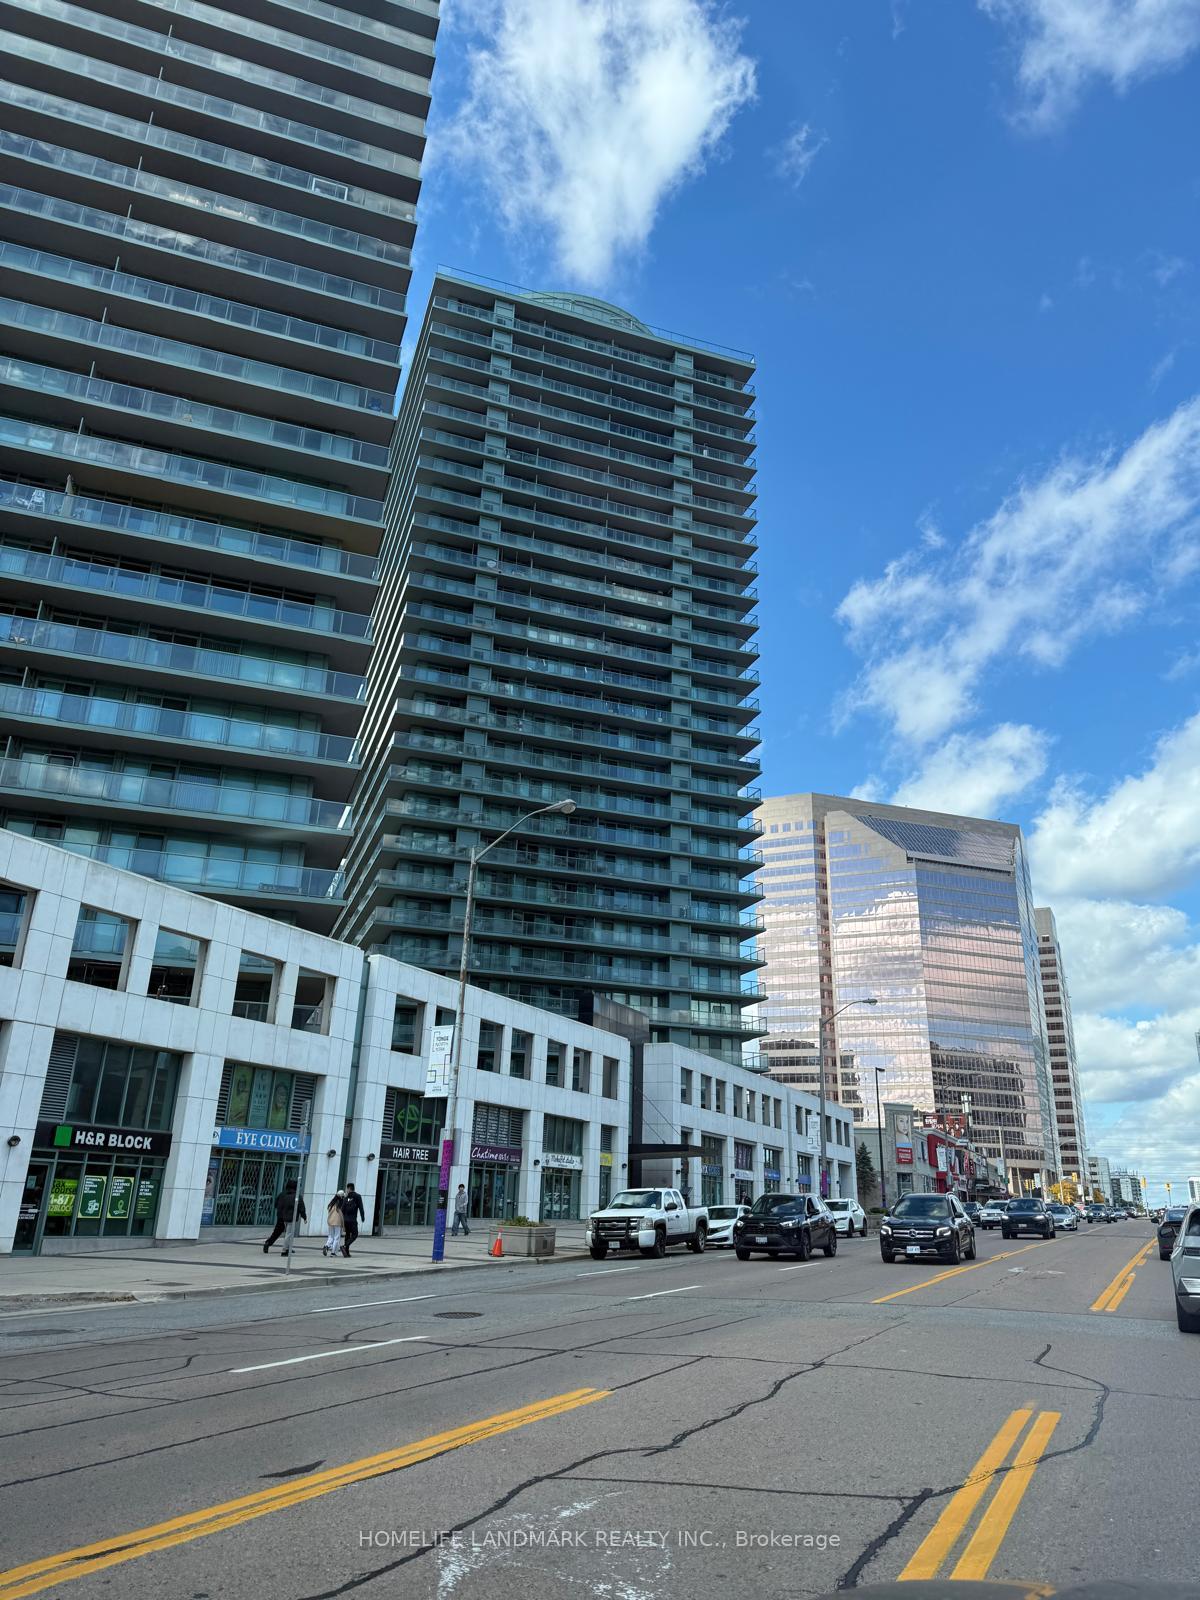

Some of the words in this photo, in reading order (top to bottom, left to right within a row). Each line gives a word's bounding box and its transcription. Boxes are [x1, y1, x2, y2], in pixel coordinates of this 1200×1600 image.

[74, 1130, 106, 1146] H&R
[107, 1133, 153, 1150] BLOCK
[235, 1131, 258, 1146] EYE
[259, 1134, 298, 1149] CLINIC
[392, 1147, 410, 1159] HAIR
[412, 1148, 429, 1161] TREE
[471, 1146, 499, 1160] Chatime
